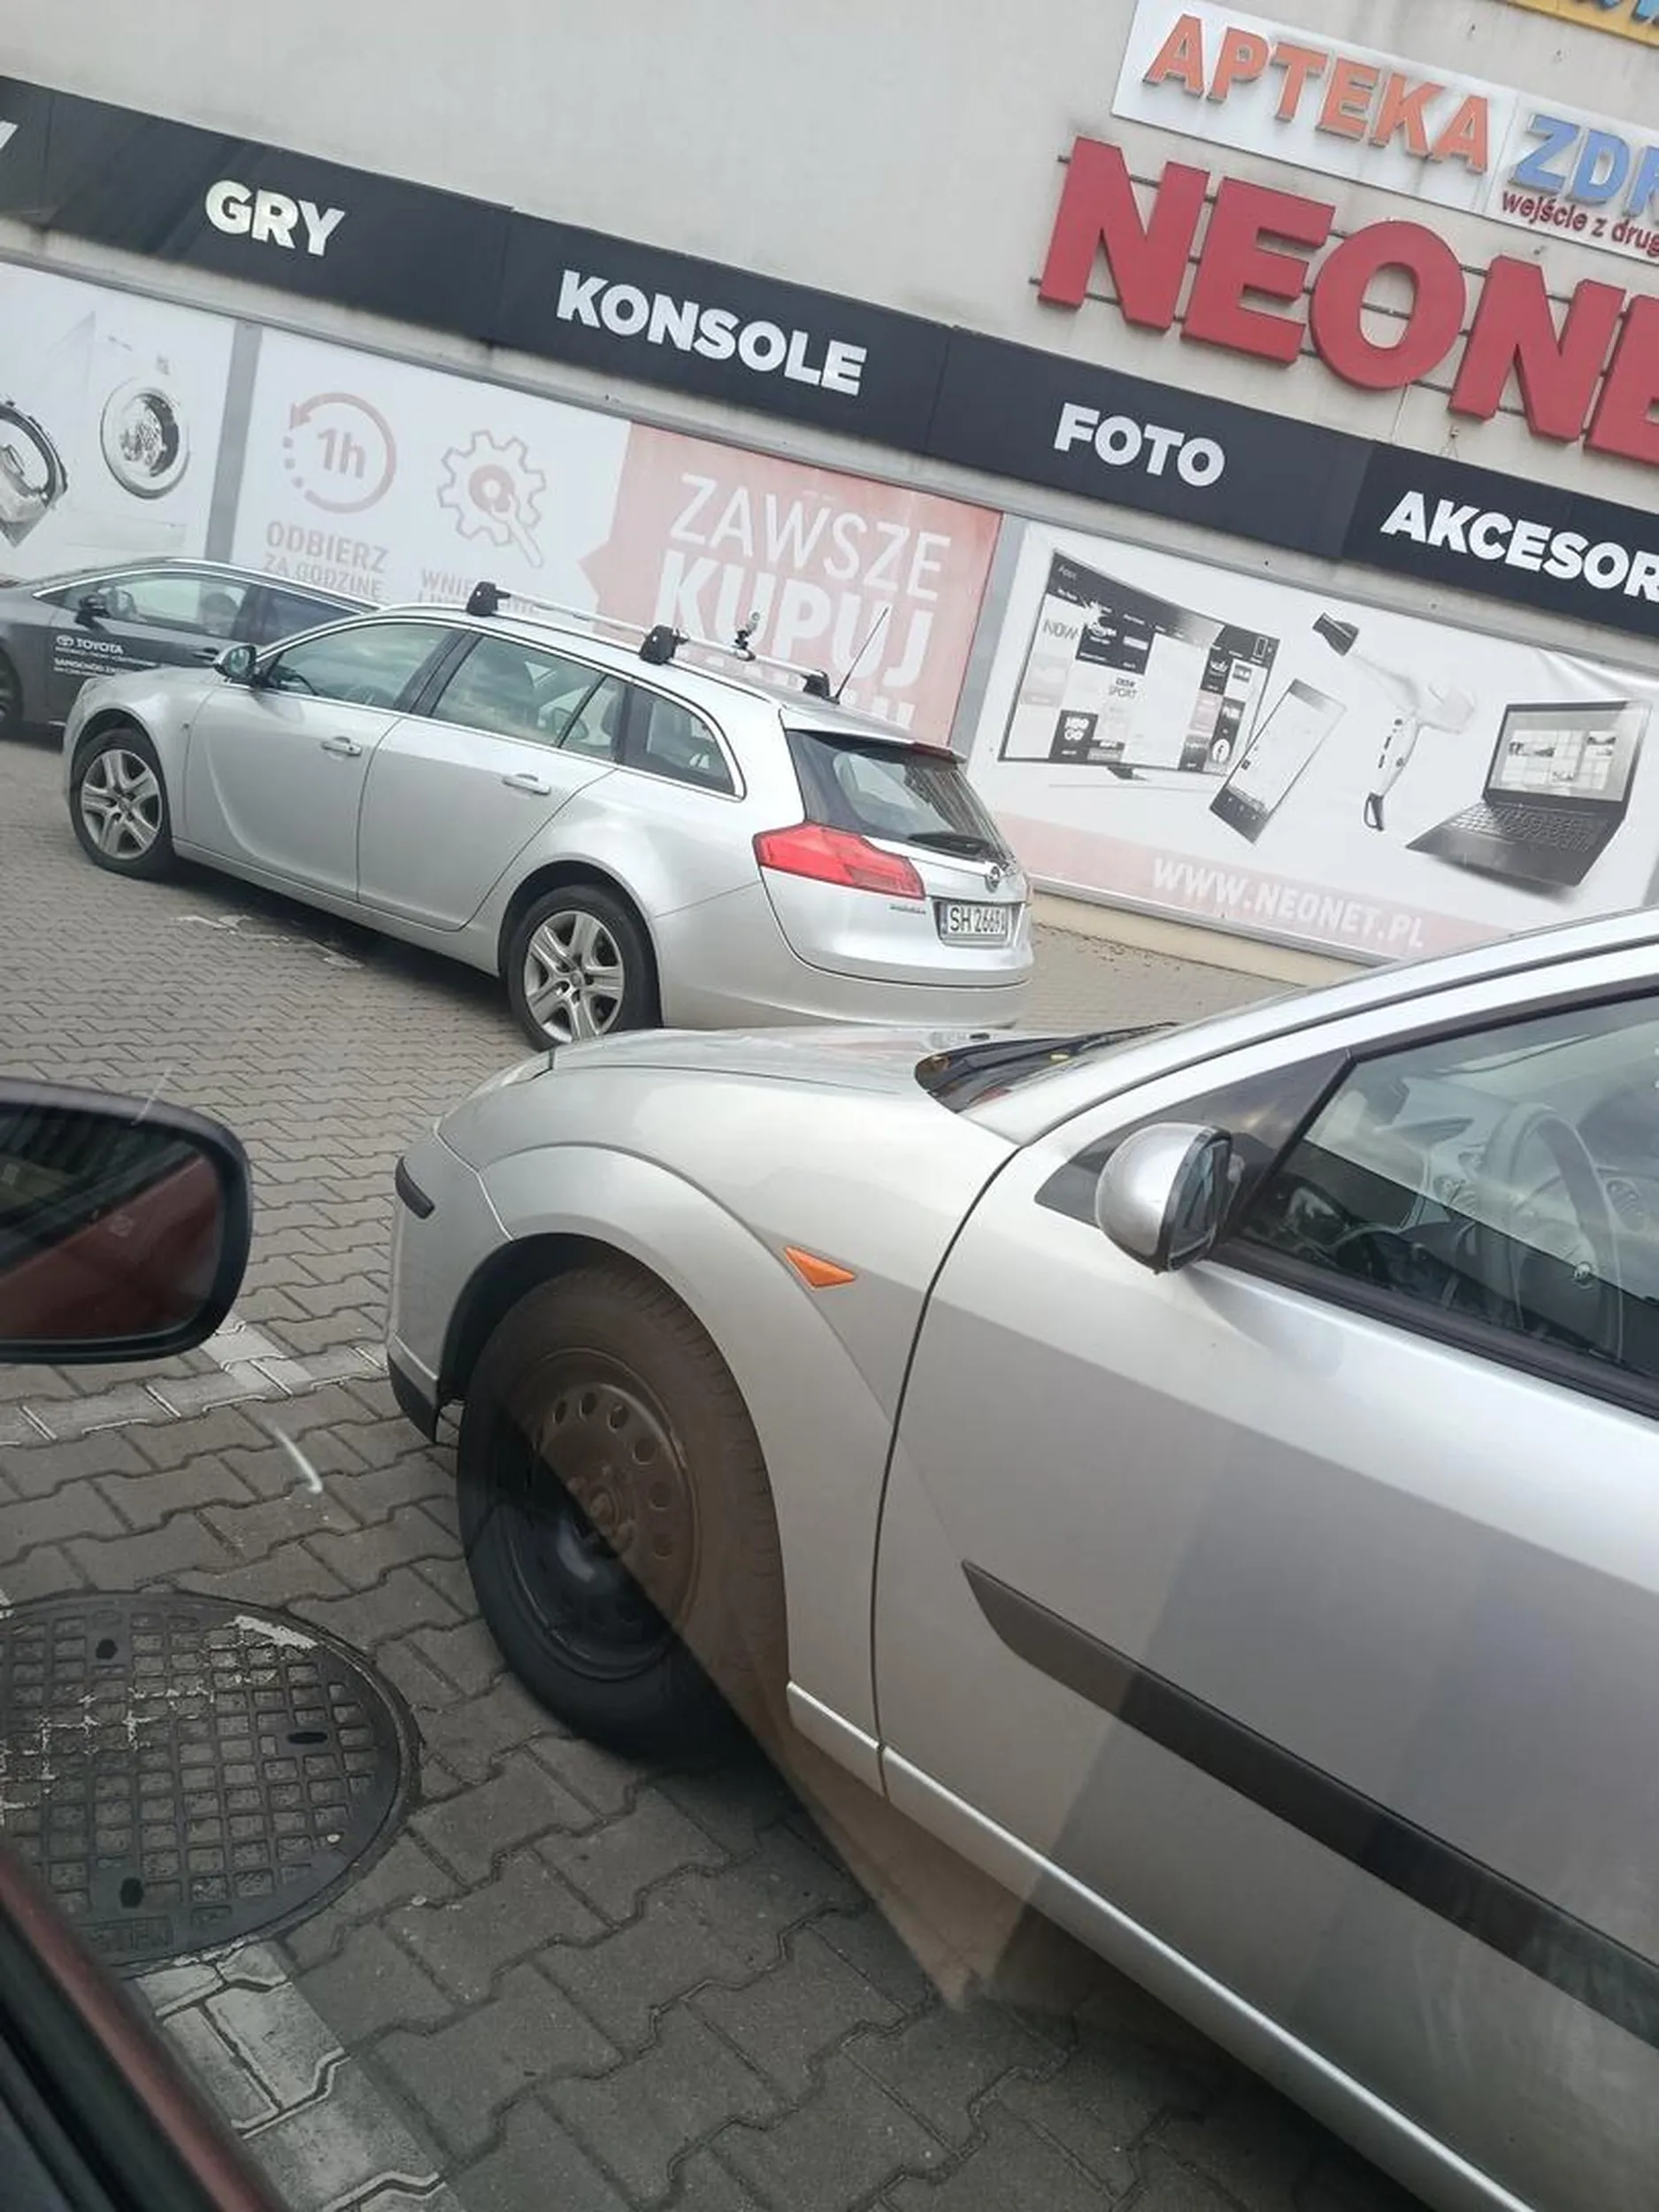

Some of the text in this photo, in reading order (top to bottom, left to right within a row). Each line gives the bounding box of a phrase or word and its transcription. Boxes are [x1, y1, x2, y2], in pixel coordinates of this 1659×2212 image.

[1142, 14, 1489, 174] APTEKA
[204, 180, 345, 256] GRY
[1502, 190, 1588, 231] wejście
[1591, 218, 1608, 237] z
[556, 270, 867, 396] KONSOLE
[317, 428, 366, 479] 1h
[1054, 403, 1225, 487] FOTO
[263, 551, 289, 577] ZA
[265, 520, 389, 573] ODBIERZ
[668, 473, 950, 601] ZAWSZE
[1380, 491, 1659, 603] AKCESOR
[76, 637, 124, 655] TOYOTA
[654, 549, 934, 689] KUPUJ
[950, 906, 972, 932] SH
[1154, 857, 1424, 949] WWW.NEONET.PL
